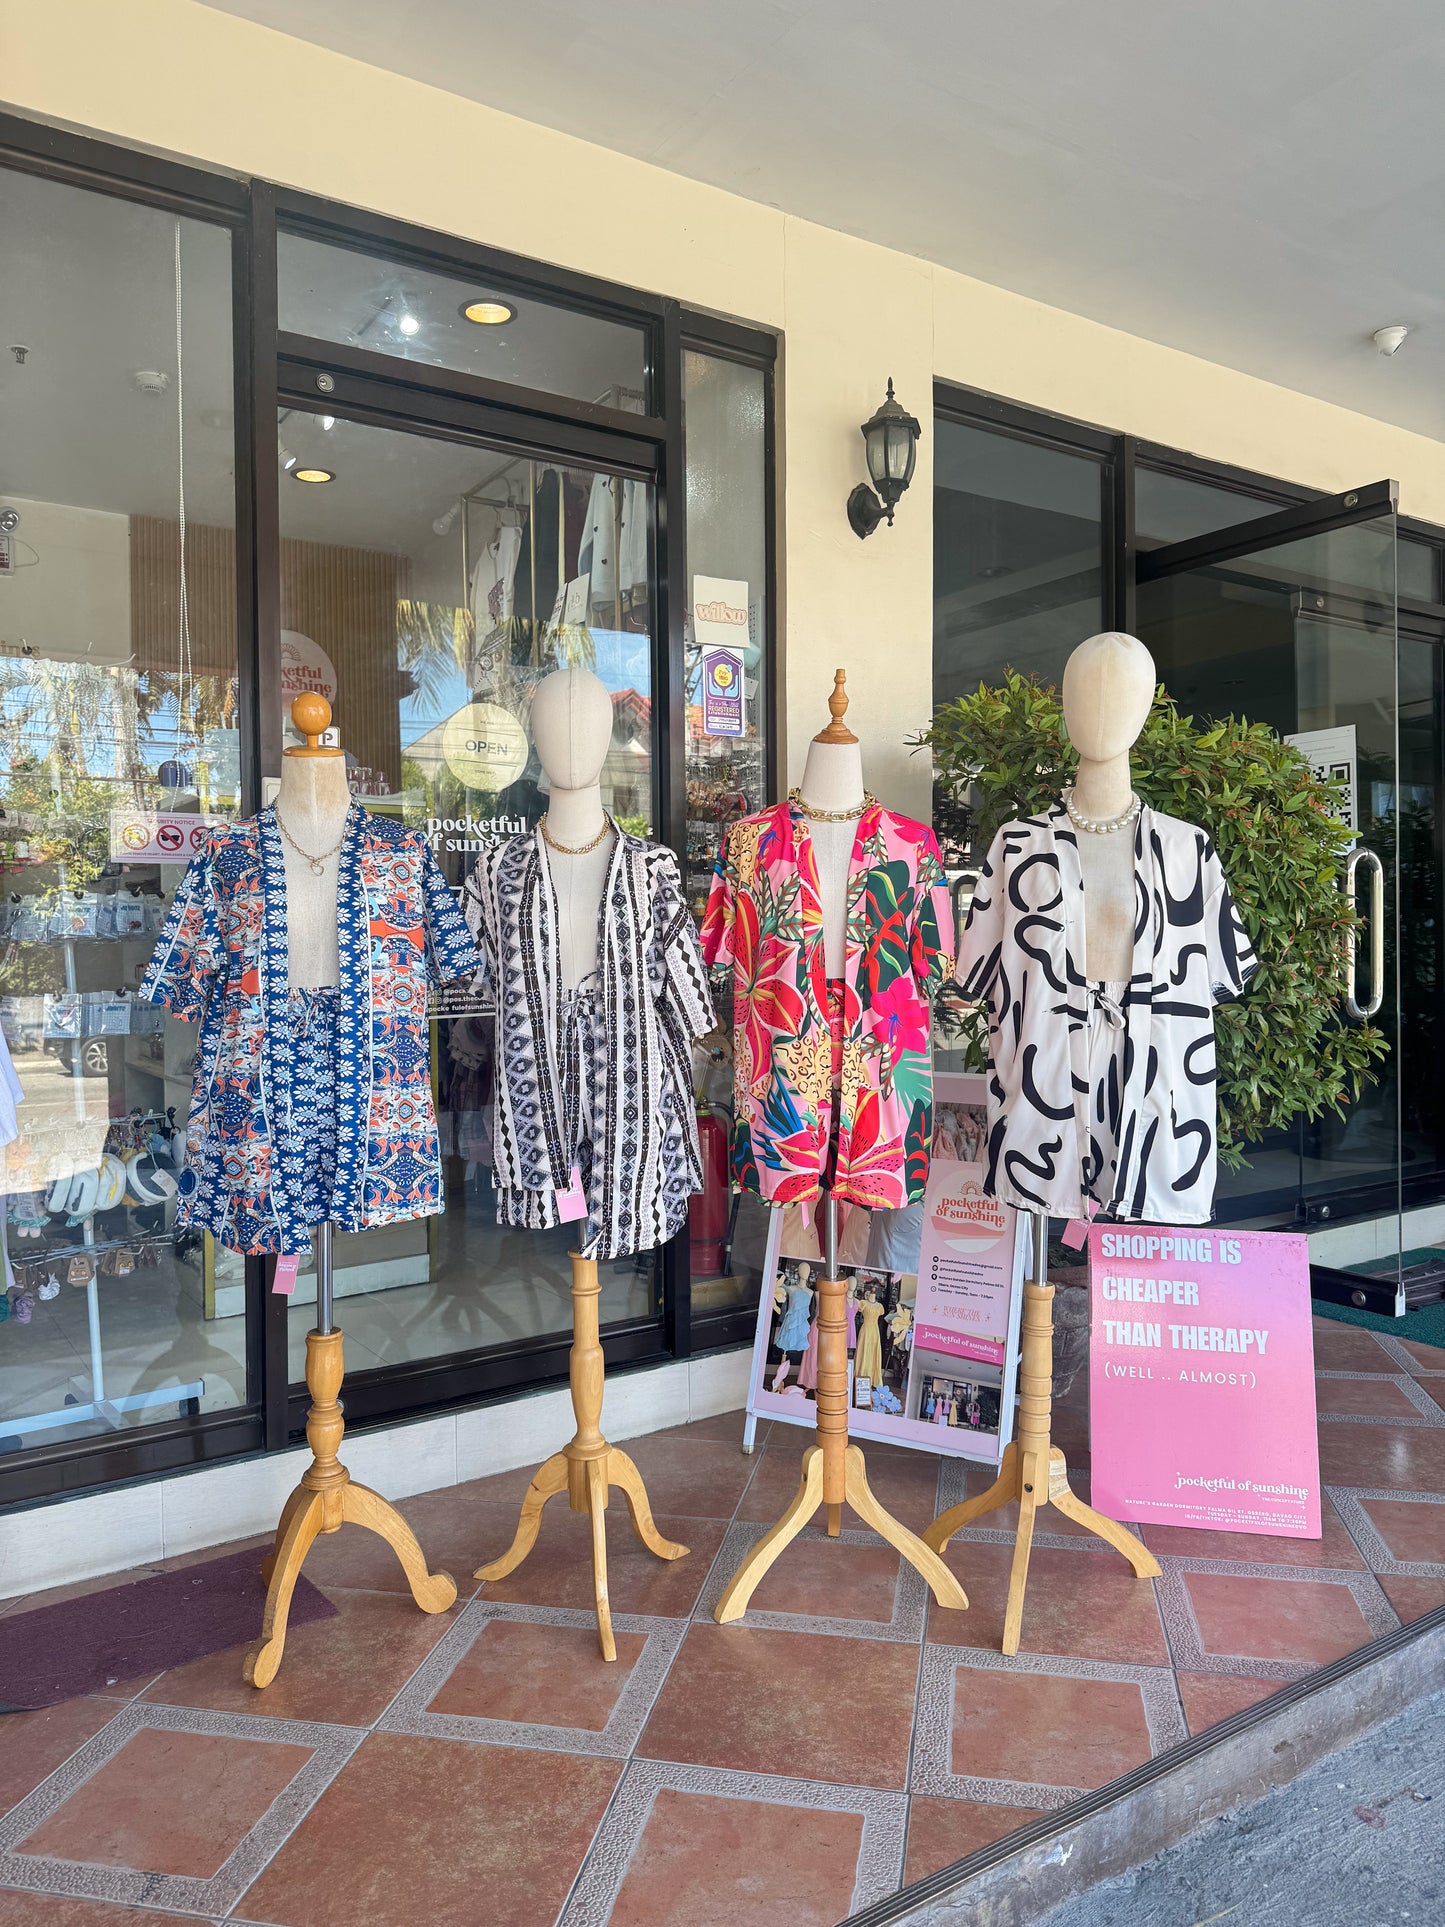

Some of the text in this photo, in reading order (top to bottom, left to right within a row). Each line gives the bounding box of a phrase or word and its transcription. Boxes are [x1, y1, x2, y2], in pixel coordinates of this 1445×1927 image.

[281, 665, 322, 680] ketful
[281, 679, 332, 698] nshine
[465, 740, 508, 755] OPEN
[426, 814, 527, 842] pocketful
[937, 1197, 998, 1213] pocketful
[936, 1207, 1005, 1227] of sunshine
[1101, 1233, 1242, 1264] SHOPPING IS
[1102, 1276, 1199, 1305] CHEAPER
[922, 1331, 960, 1344] pocketful
[1102, 1320, 1269, 1354] THAN THERAPY
[1104, 1361, 1154, 1379] (WELL
[1179, 1370, 1257, 1389] ALMOST)
[1174, 1476, 1308, 1500] pocketful of sunshine
